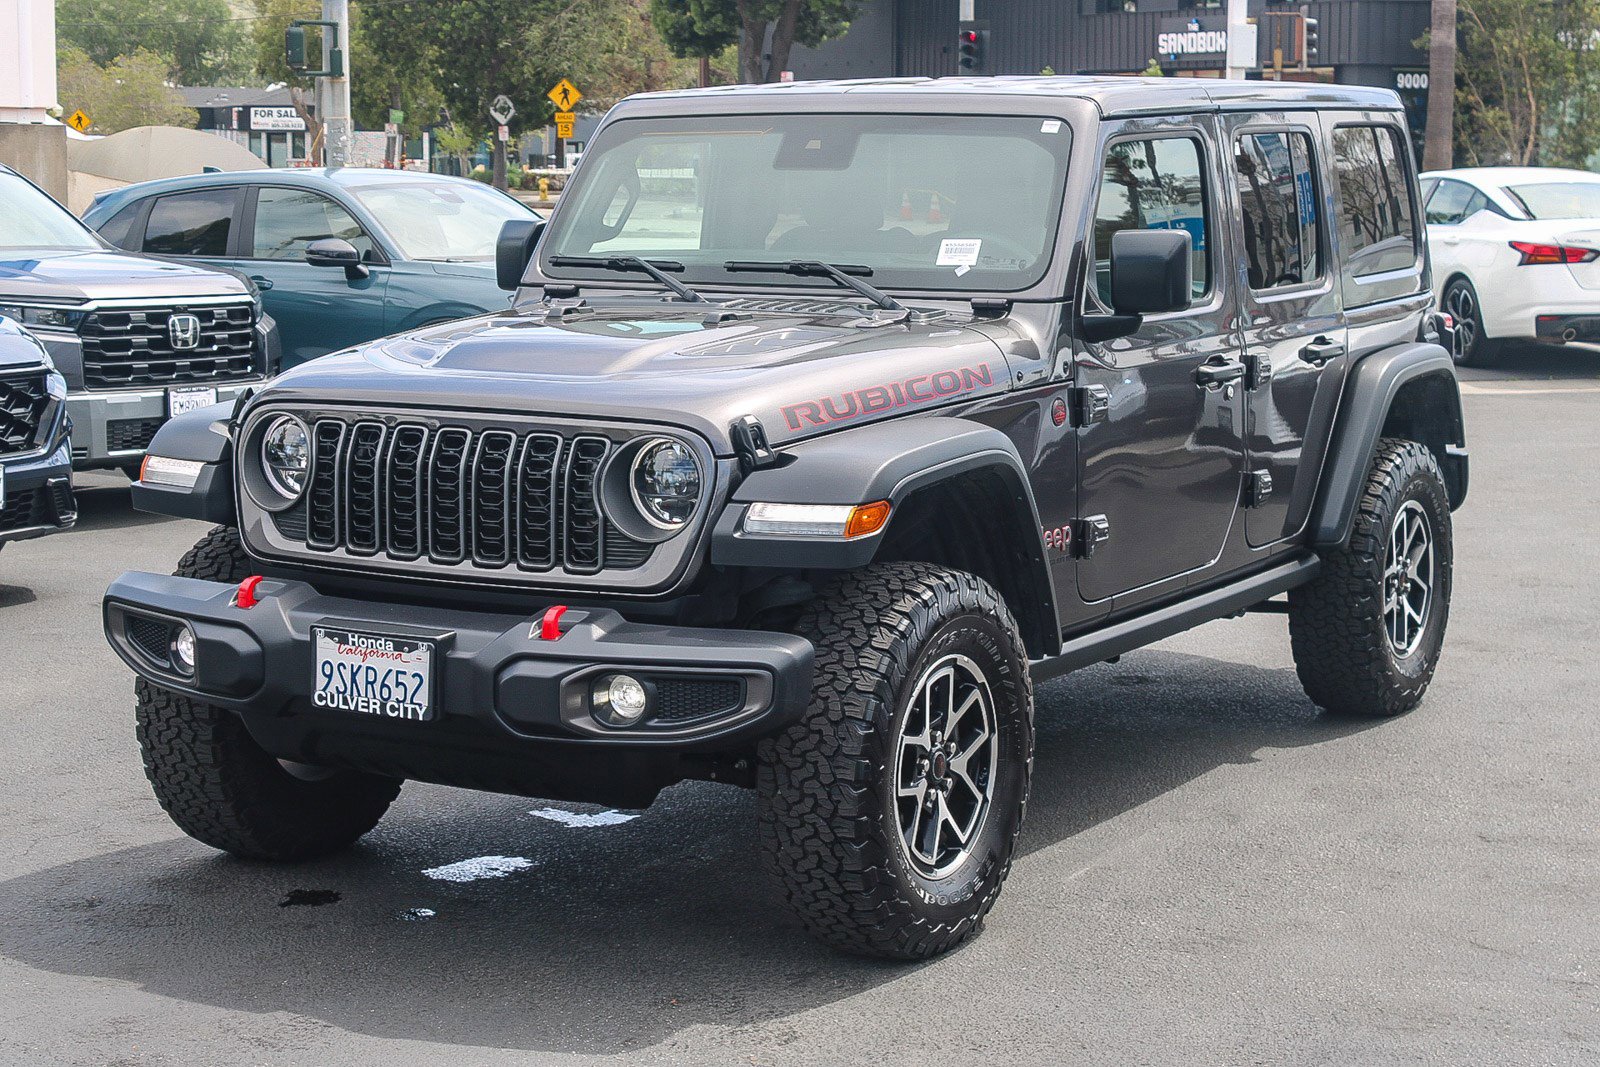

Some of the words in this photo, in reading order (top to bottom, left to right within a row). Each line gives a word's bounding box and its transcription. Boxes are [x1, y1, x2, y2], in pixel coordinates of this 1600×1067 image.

[1187, 23, 1199, 31] THE
[1158, 31, 1226, 54] SANDBOX
[1397, 73, 1428, 89] 9000
[253, 109, 273, 118] FOR
[276, 109, 299, 118] SAL
[560, 124, 570, 132] 15
[781, 362, 994, 432] RUBICON
[1041, 525, 1072, 552] eep
[337, 642, 411, 663] California
[348, 633, 394, 651] Honda
[321, 660, 425, 706] 9SKR652
[315, 691, 381, 715] CULVER
[386, 701, 427, 721] CITY
